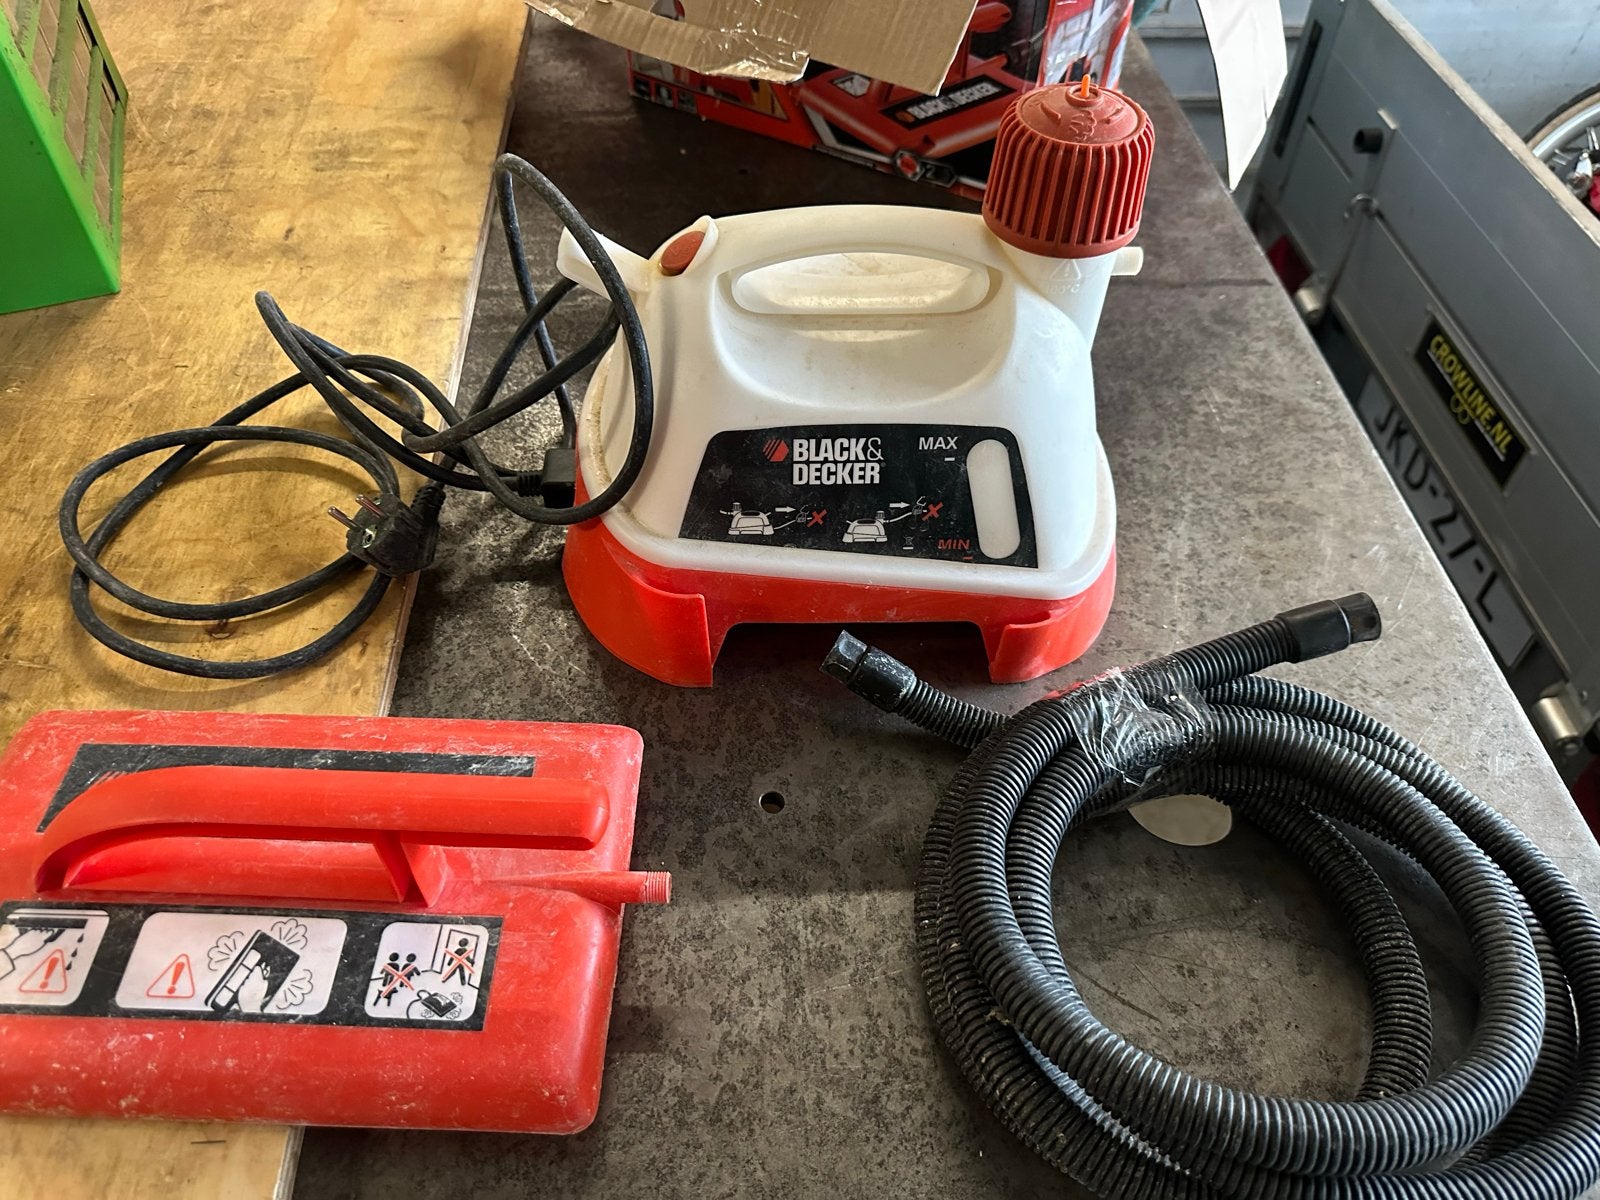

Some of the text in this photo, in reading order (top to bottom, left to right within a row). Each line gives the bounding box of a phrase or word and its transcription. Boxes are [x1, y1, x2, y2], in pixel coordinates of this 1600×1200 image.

[1429, 334, 1516, 456] CROWLINE.NL
[919, 436, 958, 450] MAX
[793, 462, 880, 485] DECKER
[937, 539, 970, 550] MIN
